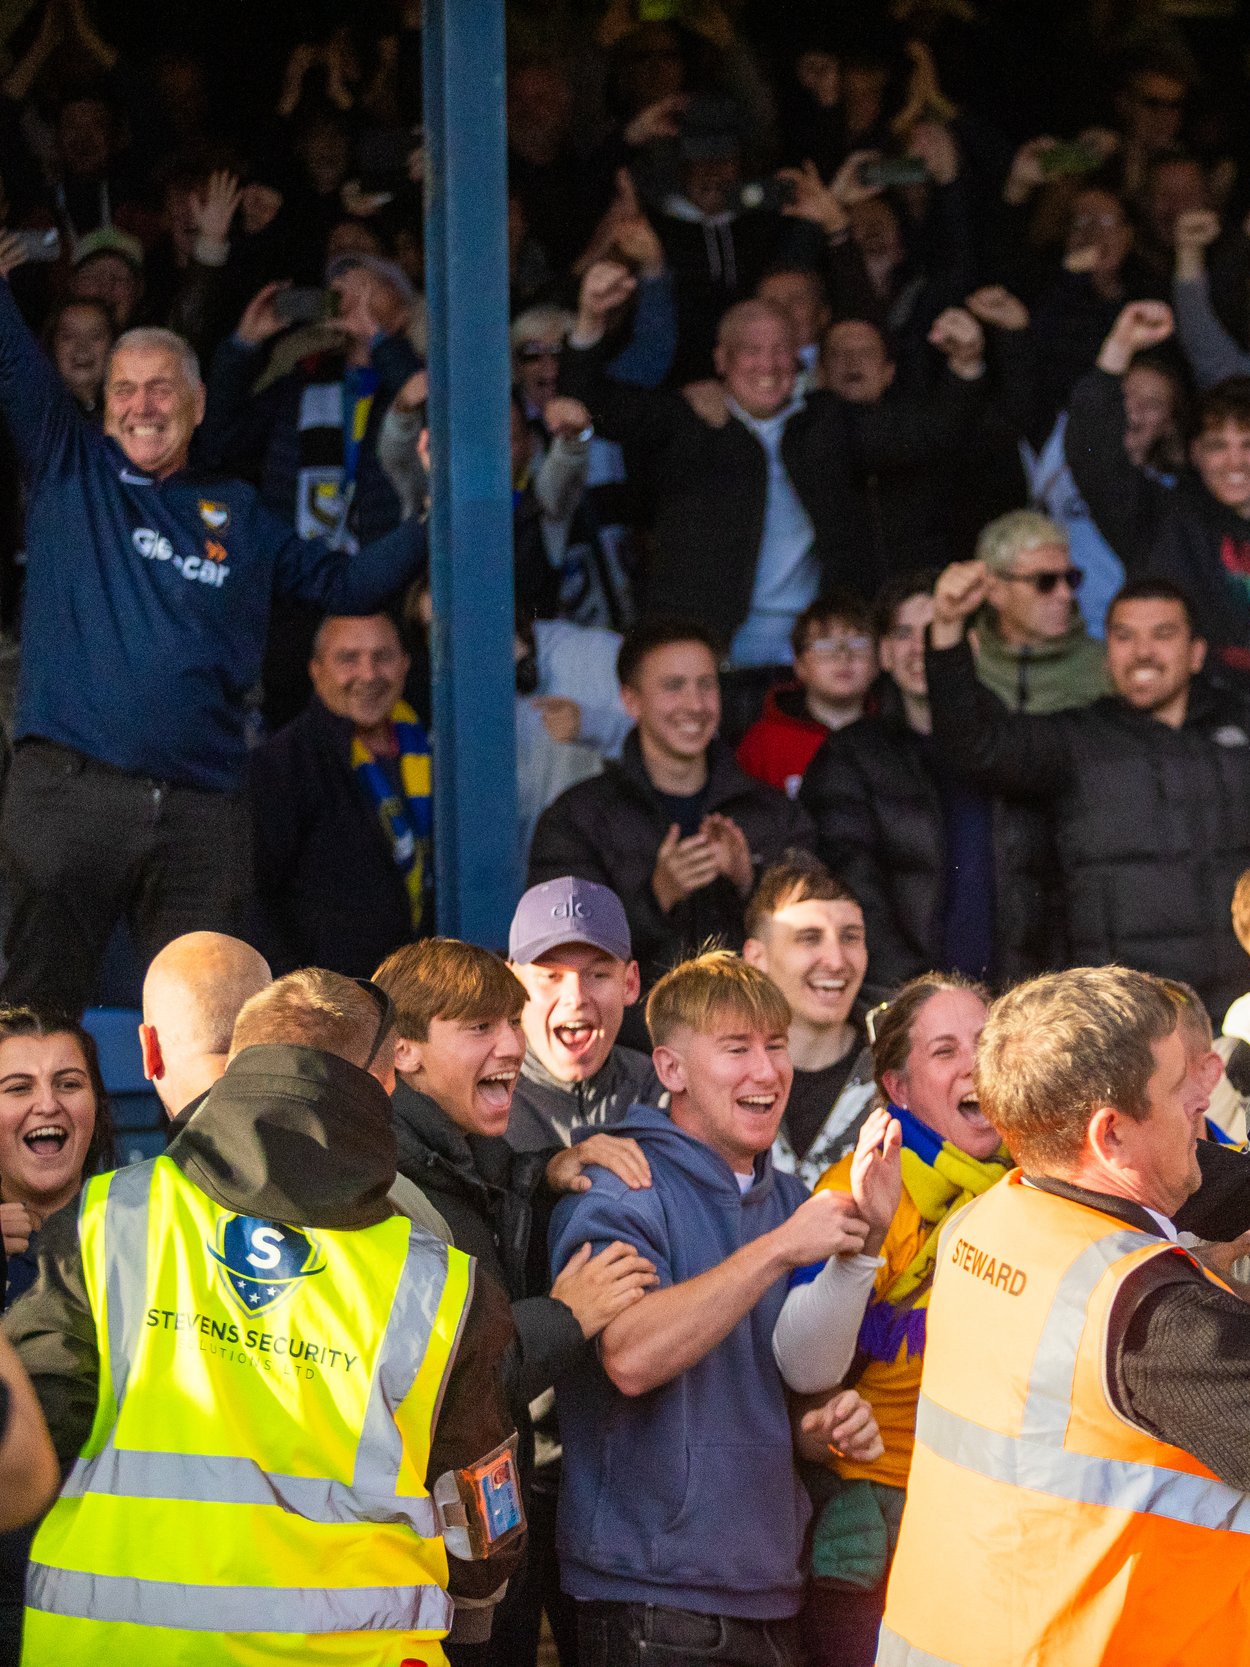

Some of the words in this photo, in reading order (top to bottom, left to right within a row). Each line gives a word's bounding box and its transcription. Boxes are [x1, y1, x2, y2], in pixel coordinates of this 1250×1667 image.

[245, 1226, 285, 1270] S
[952, 1238, 1027, 1297] STEWARD
[146, 1308, 239, 1344] STEVENS
[244, 1329, 357, 1372] SECURITY
